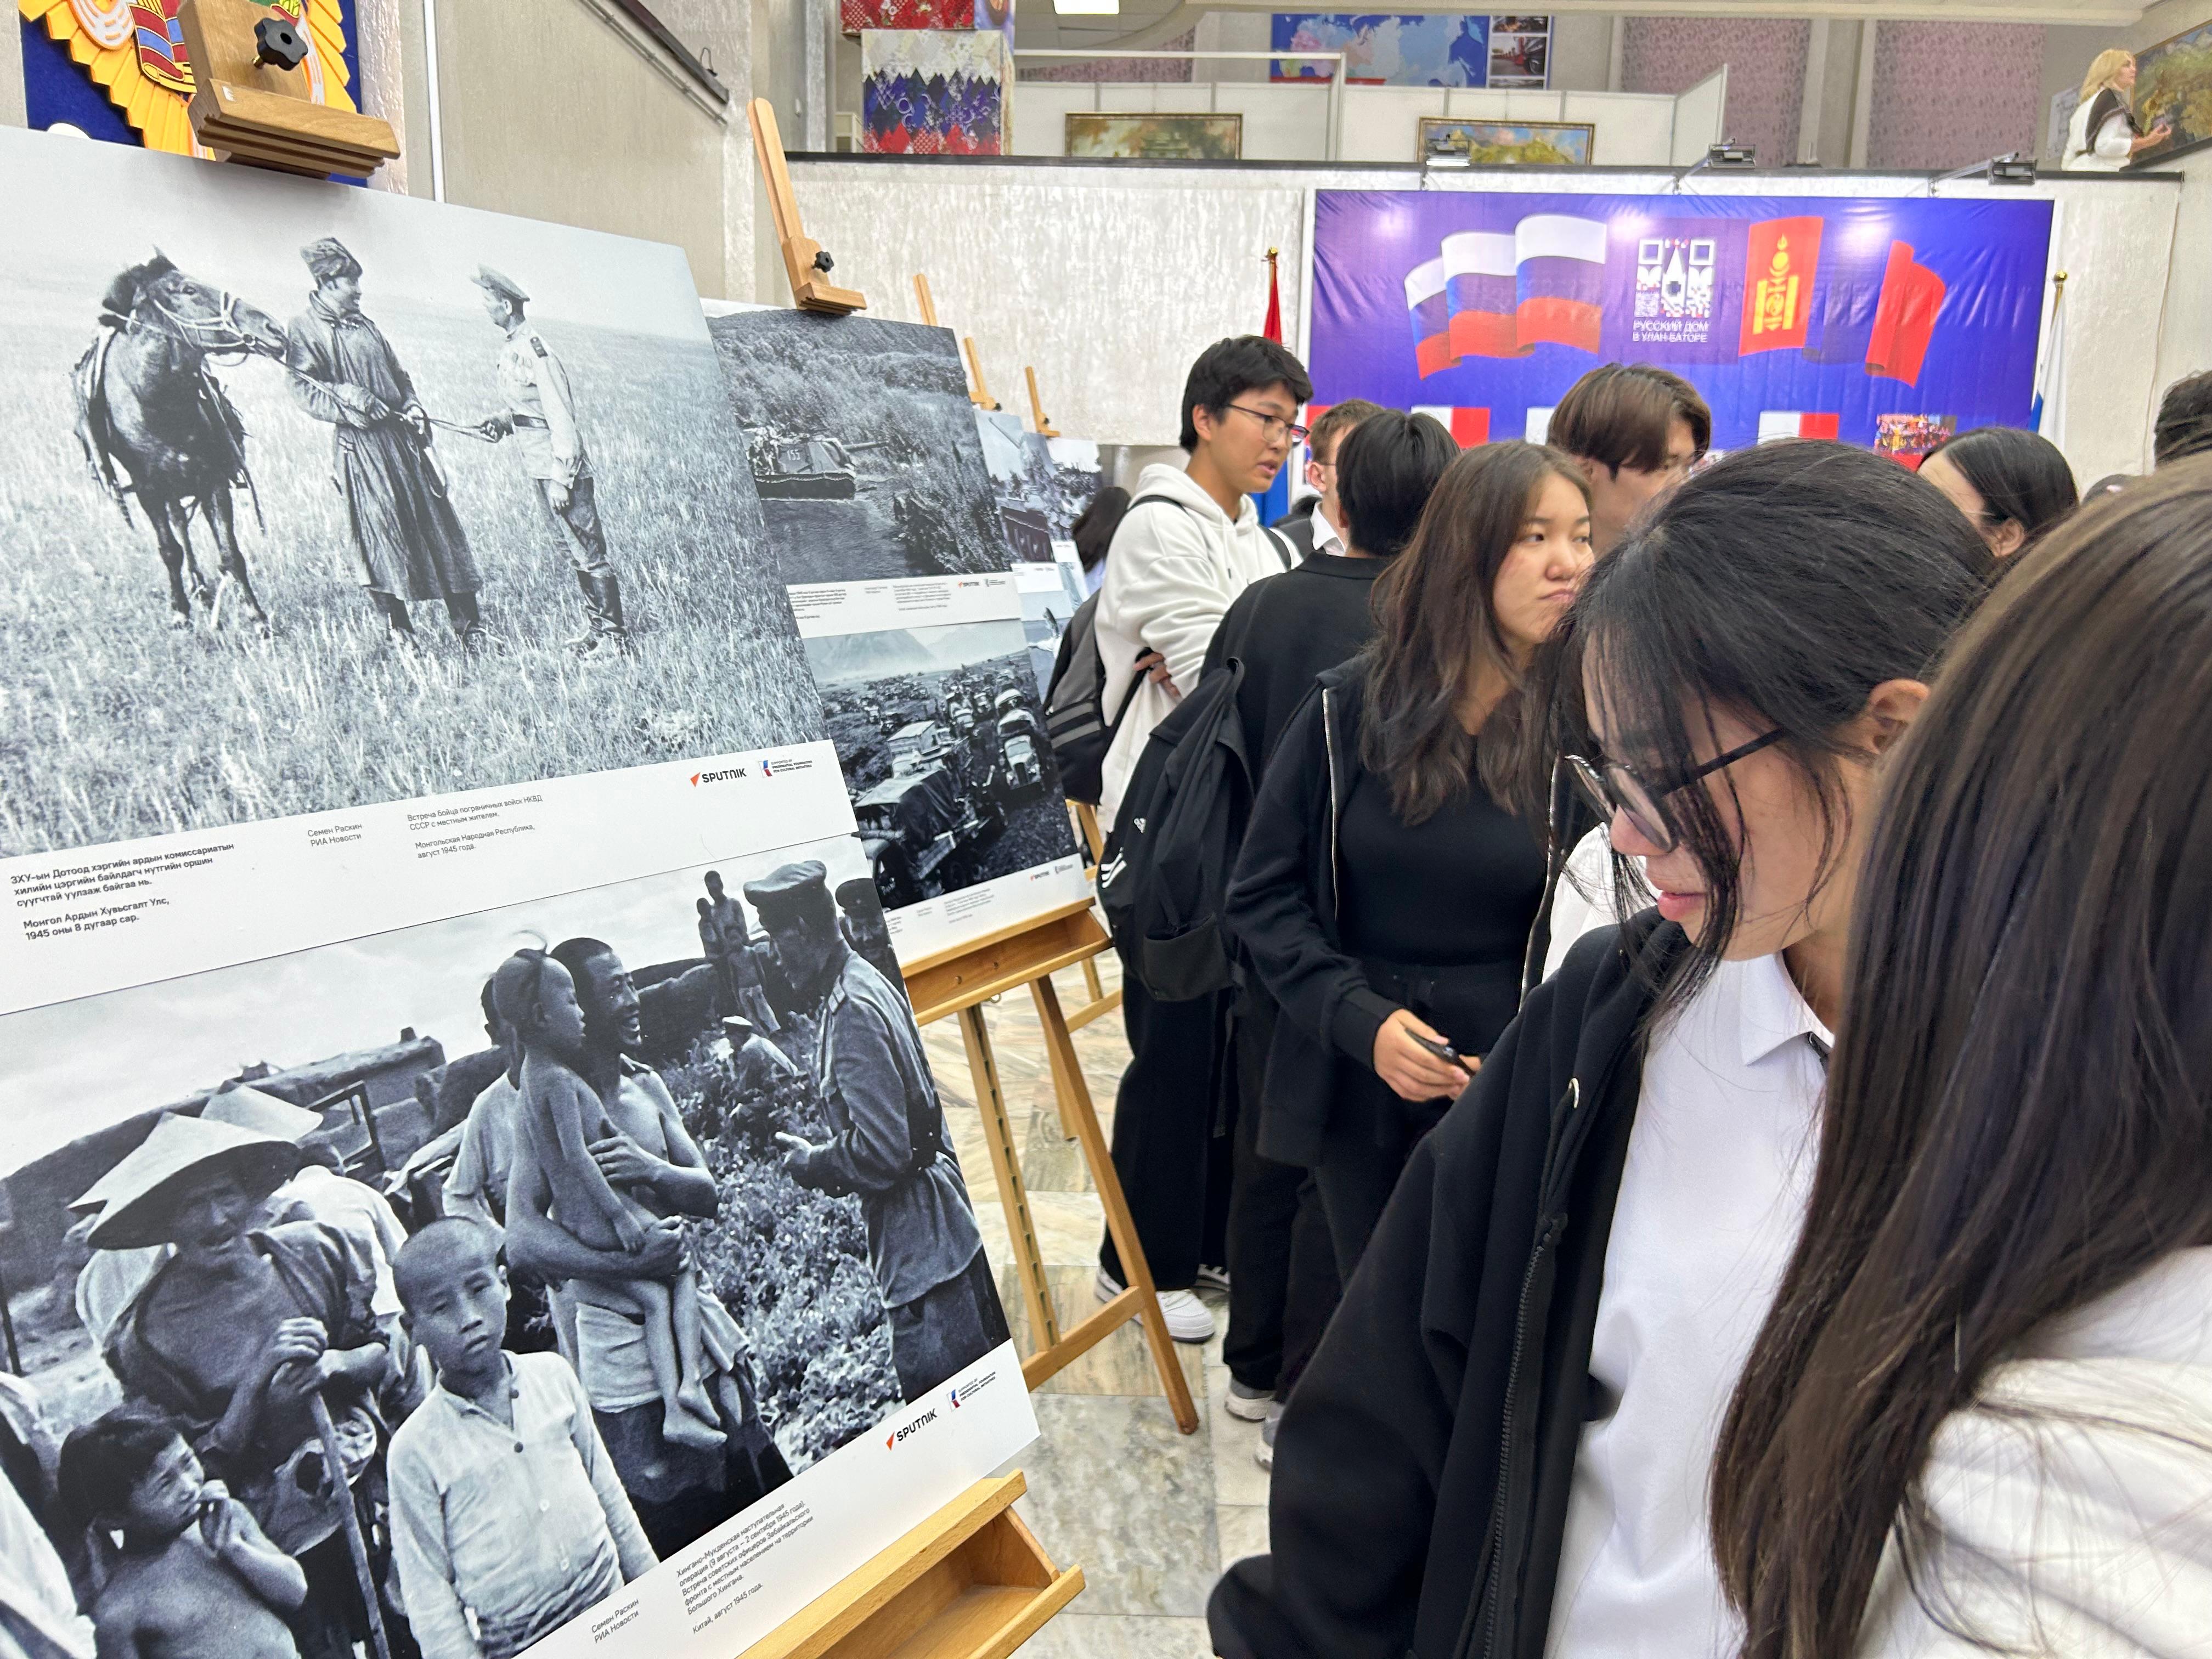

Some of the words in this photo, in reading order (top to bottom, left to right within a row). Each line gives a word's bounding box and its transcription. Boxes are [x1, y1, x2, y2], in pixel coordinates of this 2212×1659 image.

[1632, 331, 1640, 342] В
[1641, 332, 1708, 343] УЛАН-БАТОРЕ
[1633, 319, 1683, 332] РУССКИЙ
[1683, 320, 1709, 332] ДОМ
[702, 768, 747, 783] SPUTNIK
[407, 812, 437, 821] Встреча
[437, 809, 459, 817] бойца
[460, 802, 504, 813] пограничных
[523, 794, 543, 803] НКВД
[307, 828, 334, 837] Семен
[335, 824, 363, 833] Раскин
[409, 821, 430, 831] СССР
[437, 817, 467, 826] местным
[469, 812, 500, 821] жителем.
[310, 838, 328, 847] РИА
[329, 834, 362, 844] Новости
[415, 837, 461, 849] Монгольская
[461, 831, 494, 842] Народная
[495, 825, 535, 835] Республика,
[10, 873, 50, 884] ЗХУ-ын
[53, 867, 91, 879] Дотоод
[91, 859, 131, 872] хэргийн
[132, 855, 163, 866] ардын
[164, 844, 234, 860] комиссариатын
[417, 850, 440, 859] август
[441, 845, 458, 854] 1945
[14, 883, 52, 895] хилийн
[54, 876, 95, 889] цэргийн
[97, 869, 143, 882] байлдагч
[144, 862, 182, 875] нутгийн
[183, 858, 213, 868] оршин
[16, 892, 63, 908] суугчтай
[64, 887, 101, 901] уулзаж
[103, 881, 136, 892] байгаа
[23, 917, 62, 929] Монгол
[65, 911, 98, 922] Ардын
[99, 901, 148, 916] Хувьсгалт
[149, 898, 170, 906] Улс,
[25, 929, 50, 940] 1945
[52, 927, 72, 935] оны
[74, 923, 82, 932] 8
[84, 918, 117, 932] дугаар
[119, 915, 139, 923] сар.
[896, 1408, 938, 1441] SPUTNIK
[591, 1615, 614, 1633] Семен
[614, 1599, 639, 1618] Раскин
[692, 1616, 714, 1634] Китай,
[714, 1602, 733, 1620] август
[733, 1591, 748, 1605] 1945
[748, 1583, 763, 1596] года.
[594, 1629, 610, 1644] РИА
[610, 1610, 639, 1633] Новости
